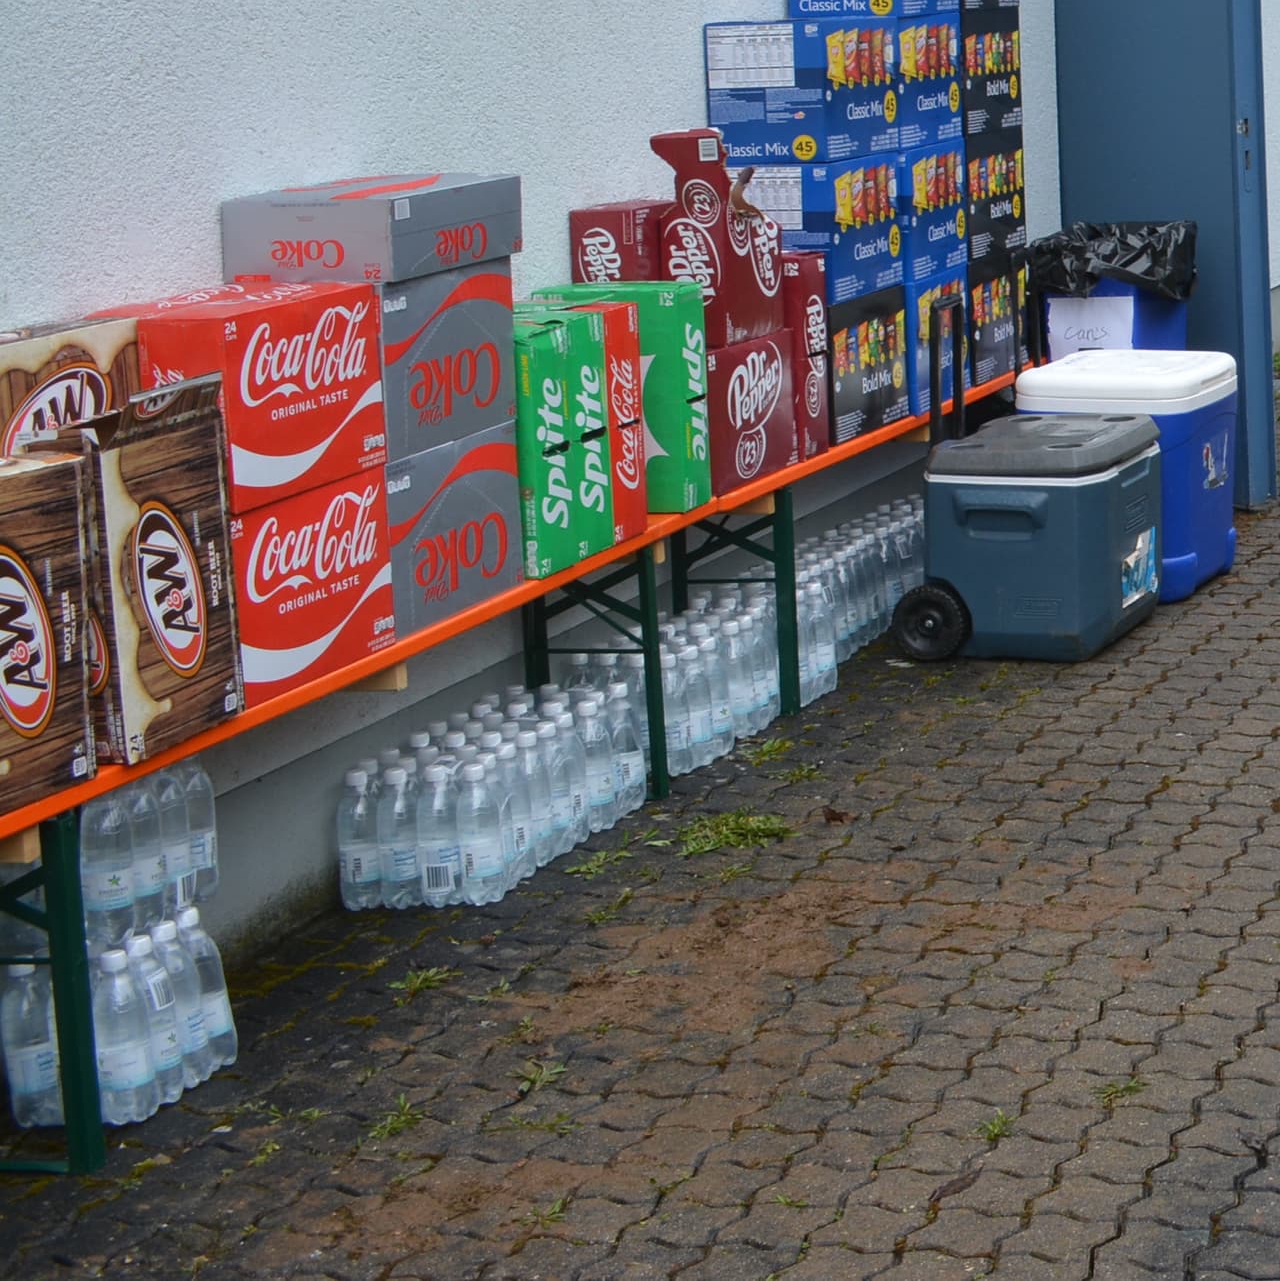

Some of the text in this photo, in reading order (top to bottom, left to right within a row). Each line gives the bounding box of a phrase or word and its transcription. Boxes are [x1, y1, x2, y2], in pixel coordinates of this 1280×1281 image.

[951, 90, 958, 103] 45
[986, 79, 1009, 96] Bold Mix
[847, 102, 883, 120] Classic Mix
[886, 98, 895, 112] 45
[917, 93, 949, 111] Classic Mix
[765, 143, 789, 156] Mix
[795, 142, 813, 153] 45
[990, 204, 1003, 219] Bold
[890, 233, 900, 247] 45
[928, 223, 956, 242] Classic Mix
[271, 239, 344, 268] Coke
[435, 222, 488, 266] Coke
[854, 238, 888, 260] Classic Mix
[581, 230, 616, 283] Peppe
[602, 251, 622, 279] Dr
[364, 269, 381, 280] 24
[791, 262, 799, 277] 24
[664, 291, 674, 307] 24
[224, 322, 237, 334] 24
[994, 327, 1005, 343] Bold
[240, 301, 371, 407] Coca-Cola
[746, 350, 767, 380] Dr
[408, 341, 500, 417] Coke
[862, 370, 892, 394] Bold Mix
[271, 388, 349, 421] ORIGINAL TASTE
[729, 359, 780, 431] Pepper
[744, 441, 757, 464] 23
[230, 519, 243, 533] 24
[246, 482, 380, 604] Coca-Cola
[414, 511, 508, 592] Coke
[579, 541, 586, 557] 24
[207, 540, 219, 607] ROOT BEER
[542, 559, 549, 575] 24
[139, 541, 201, 634] A&W
[279, 574, 360, 614] ORIGINAL TASTE
[61, 590, 72, 663] ROOT BEER
